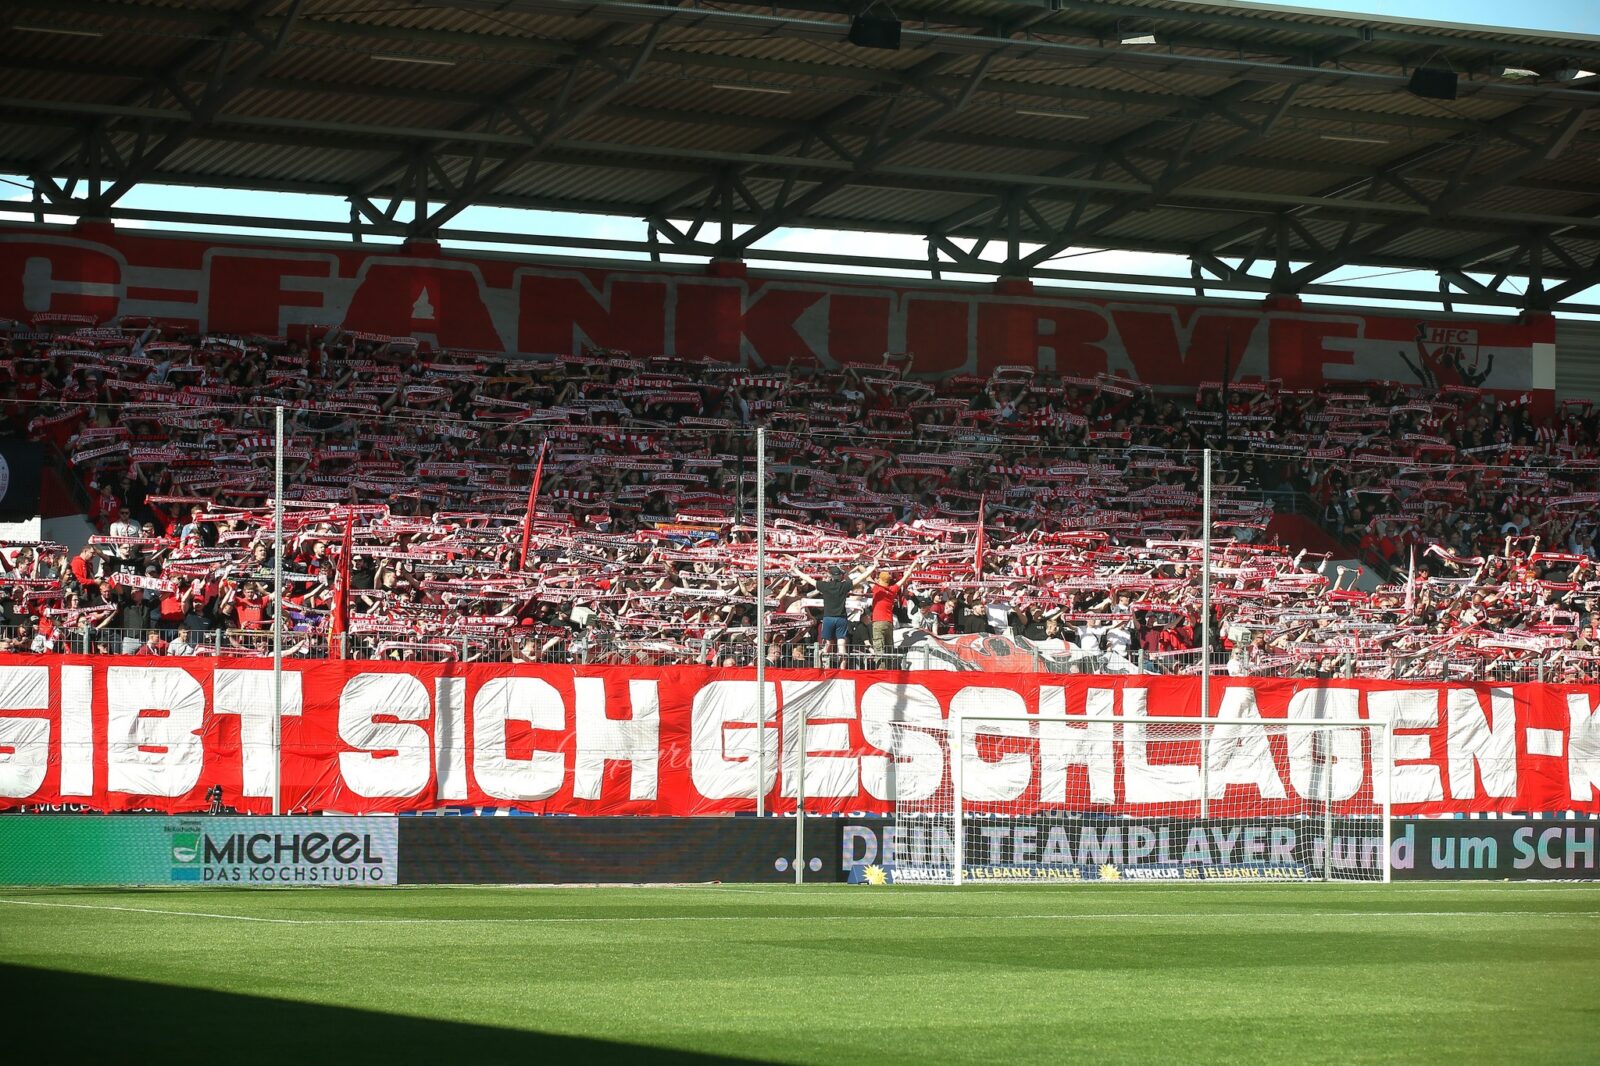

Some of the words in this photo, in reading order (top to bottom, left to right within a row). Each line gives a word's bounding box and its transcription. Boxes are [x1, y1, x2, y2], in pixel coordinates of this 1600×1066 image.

[1434, 328, 1468, 342] HFC
[337, 672, 661, 802] SICH
[980, 826, 1297, 866] TEAMPLAYER
[1312, 823, 1415, 870] rund
[1431, 837, 1498, 870] um
[1512, 827, 1600, 870] SCH
[203, 867, 241, 881] DAS
[249, 867, 384, 881] KOCHSTUDIO
[891, 868, 948, 880] MERKUR
[1036, 867, 1081, 879] HALLE
[1124, 867, 1180, 879] MERKUR
[1264, 866, 1306, 879] HALLE
